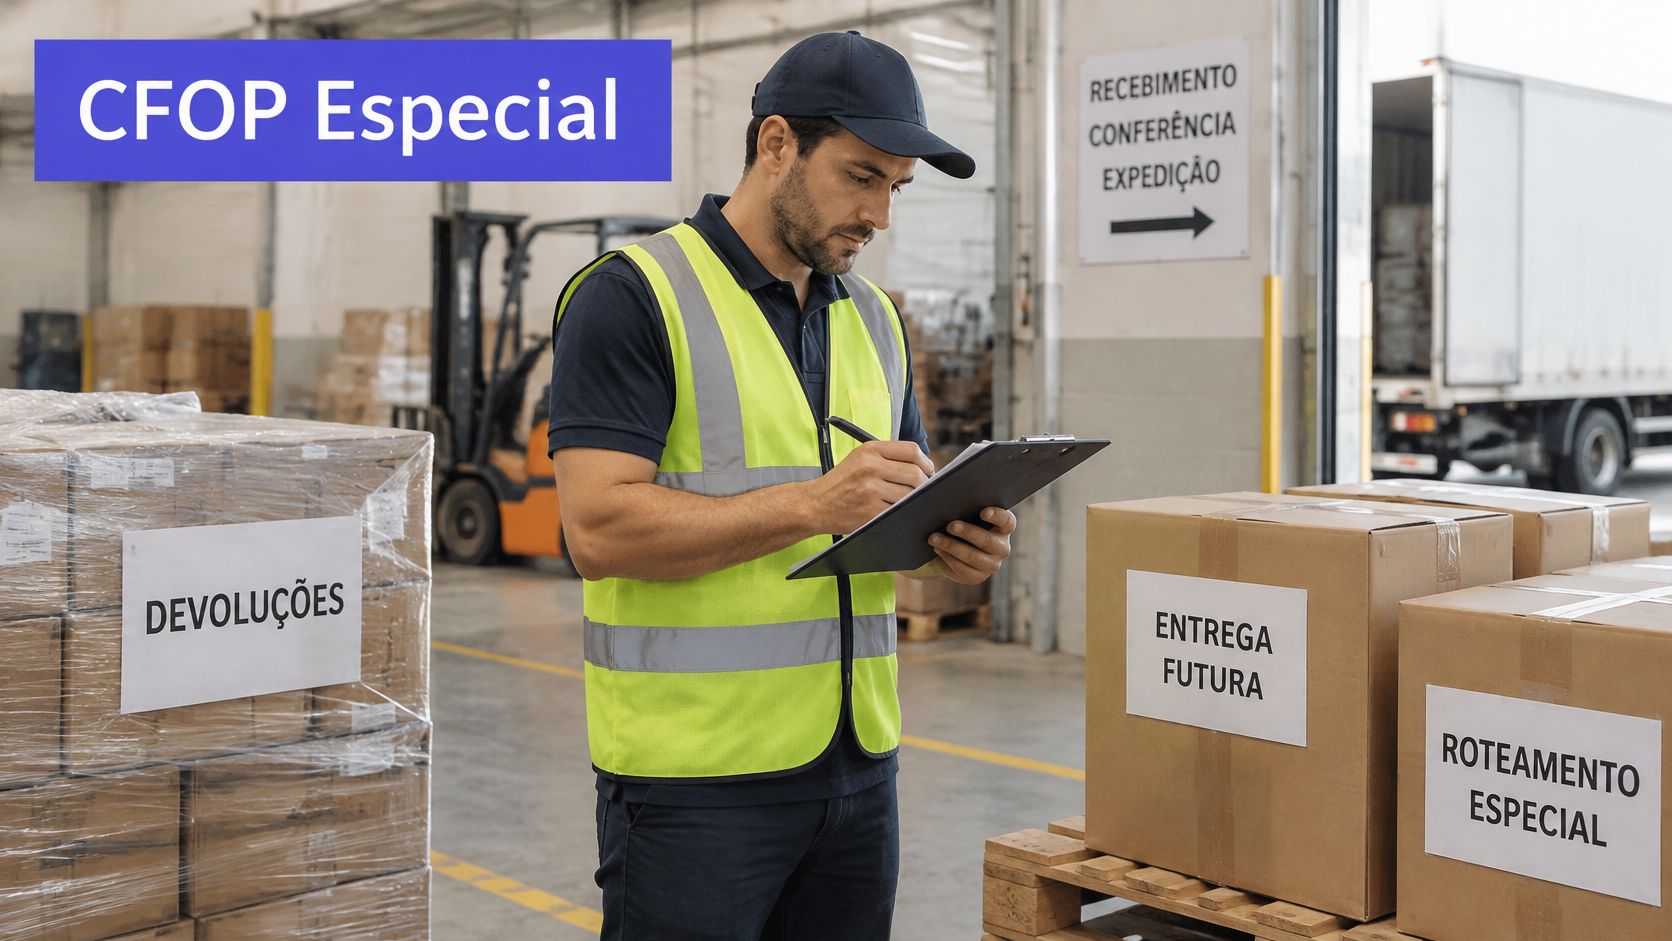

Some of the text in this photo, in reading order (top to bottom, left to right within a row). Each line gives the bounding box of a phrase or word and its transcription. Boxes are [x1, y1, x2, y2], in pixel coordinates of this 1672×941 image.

[1089, 64, 1238, 102] RECEBIMENTO
[1088, 110, 1237, 147] CONFERÊNCIA
[1102, 155, 1221, 192] EXPEDIÇÃO
[145, 577, 345, 635] DEVOLUÇÕES
[1155, 611, 1273, 655] ENTREGA
[1162, 657, 1264, 701] FUTURA
[1441, 732, 1641, 798] ROTEAMENTO
[1470, 789, 1607, 848] ESPECIAL
